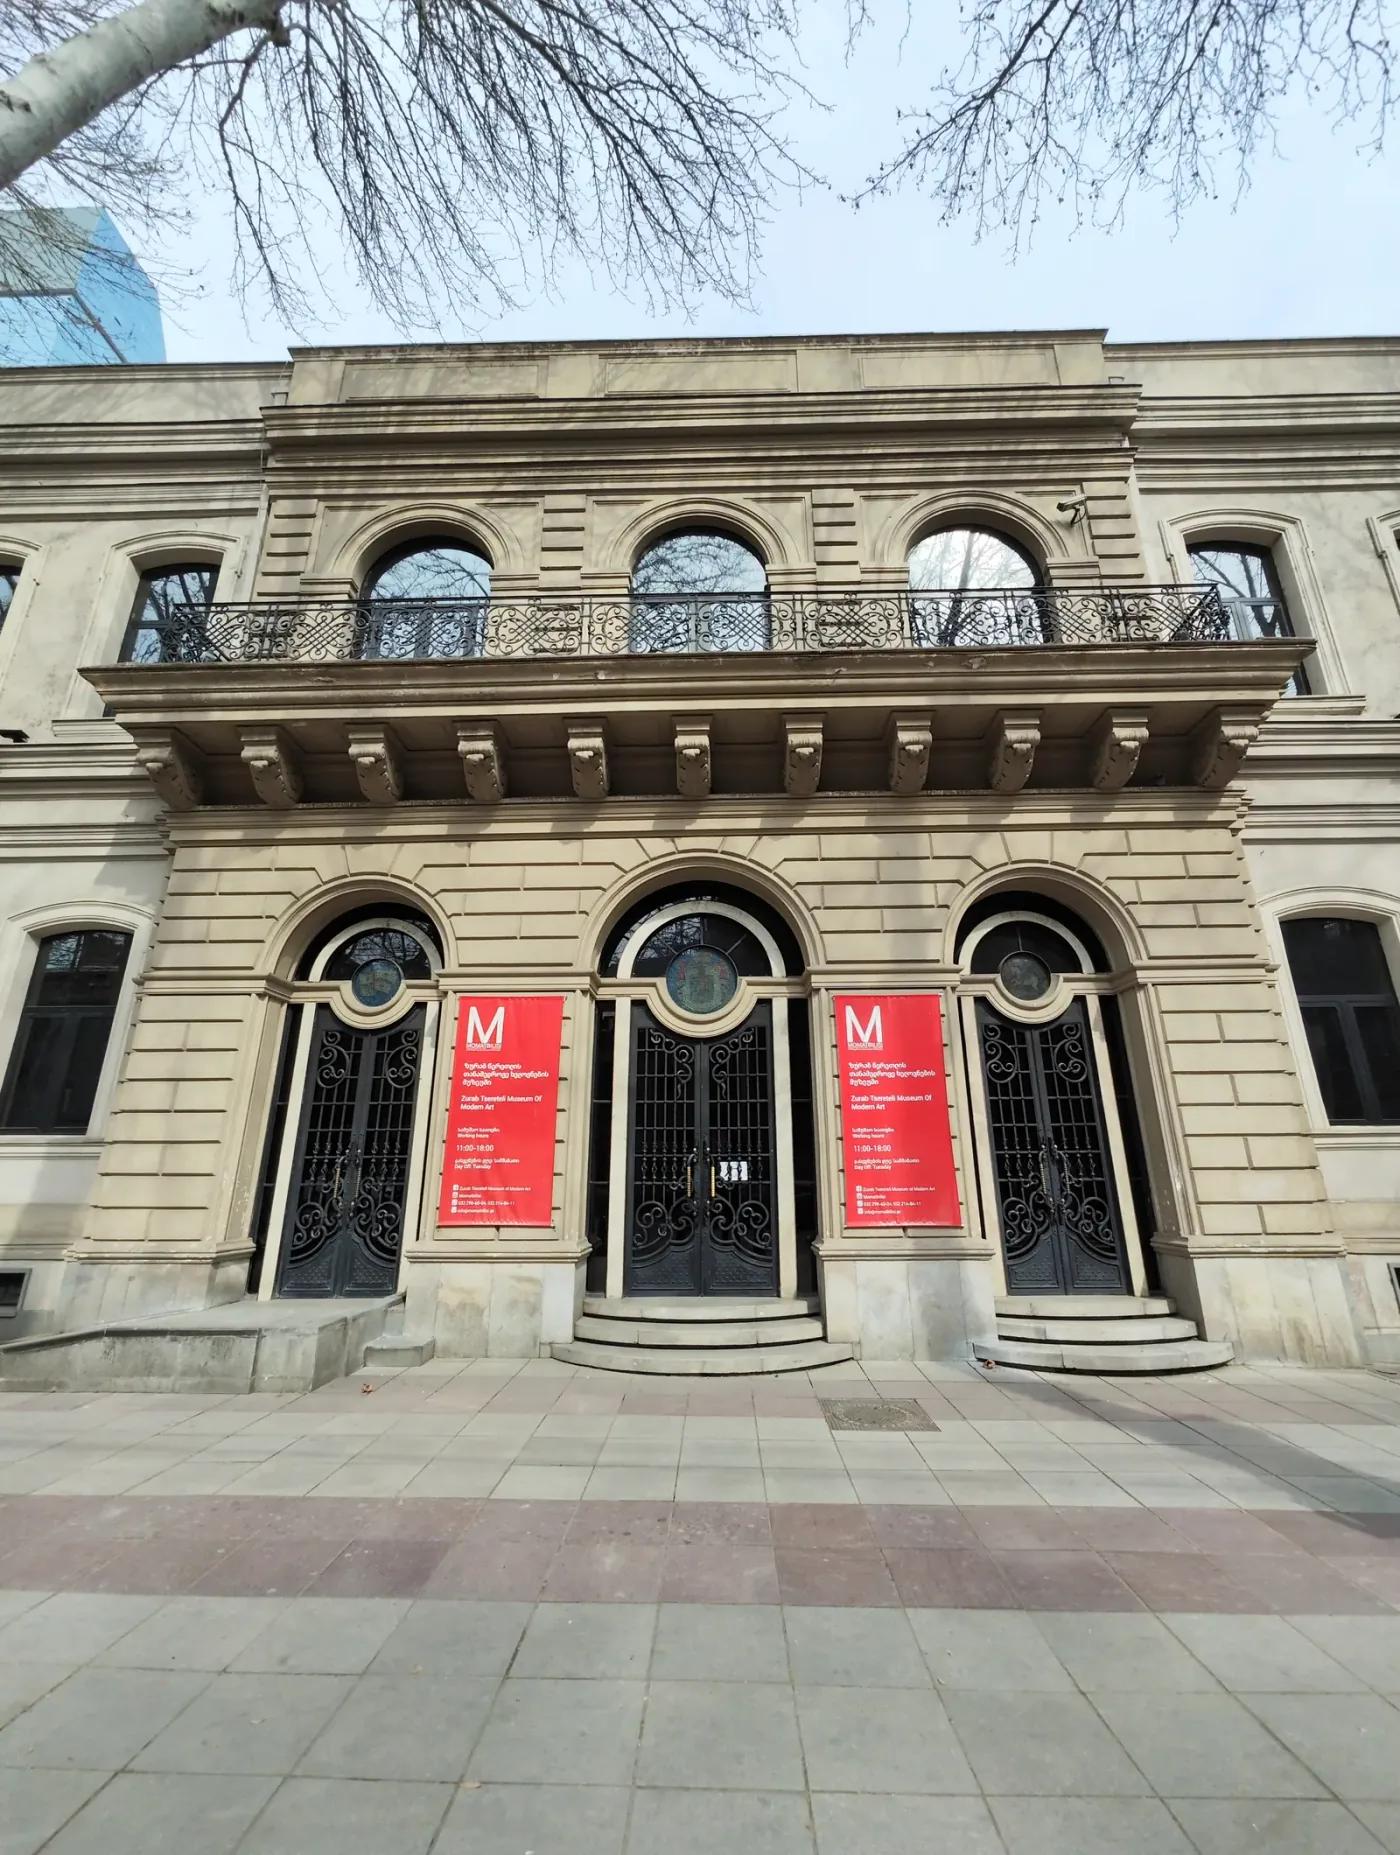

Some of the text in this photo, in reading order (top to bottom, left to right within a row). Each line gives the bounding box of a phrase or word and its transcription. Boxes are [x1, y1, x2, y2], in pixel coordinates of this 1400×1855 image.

[467, 1006, 505, 1043] M
[845, 1005, 883, 1043] M
[534, 1095, 543, 1103] Of
[456, 1144, 495, 1152] 11:00-18:00
[854, 1144, 892, 1152] 11:00-18:00
